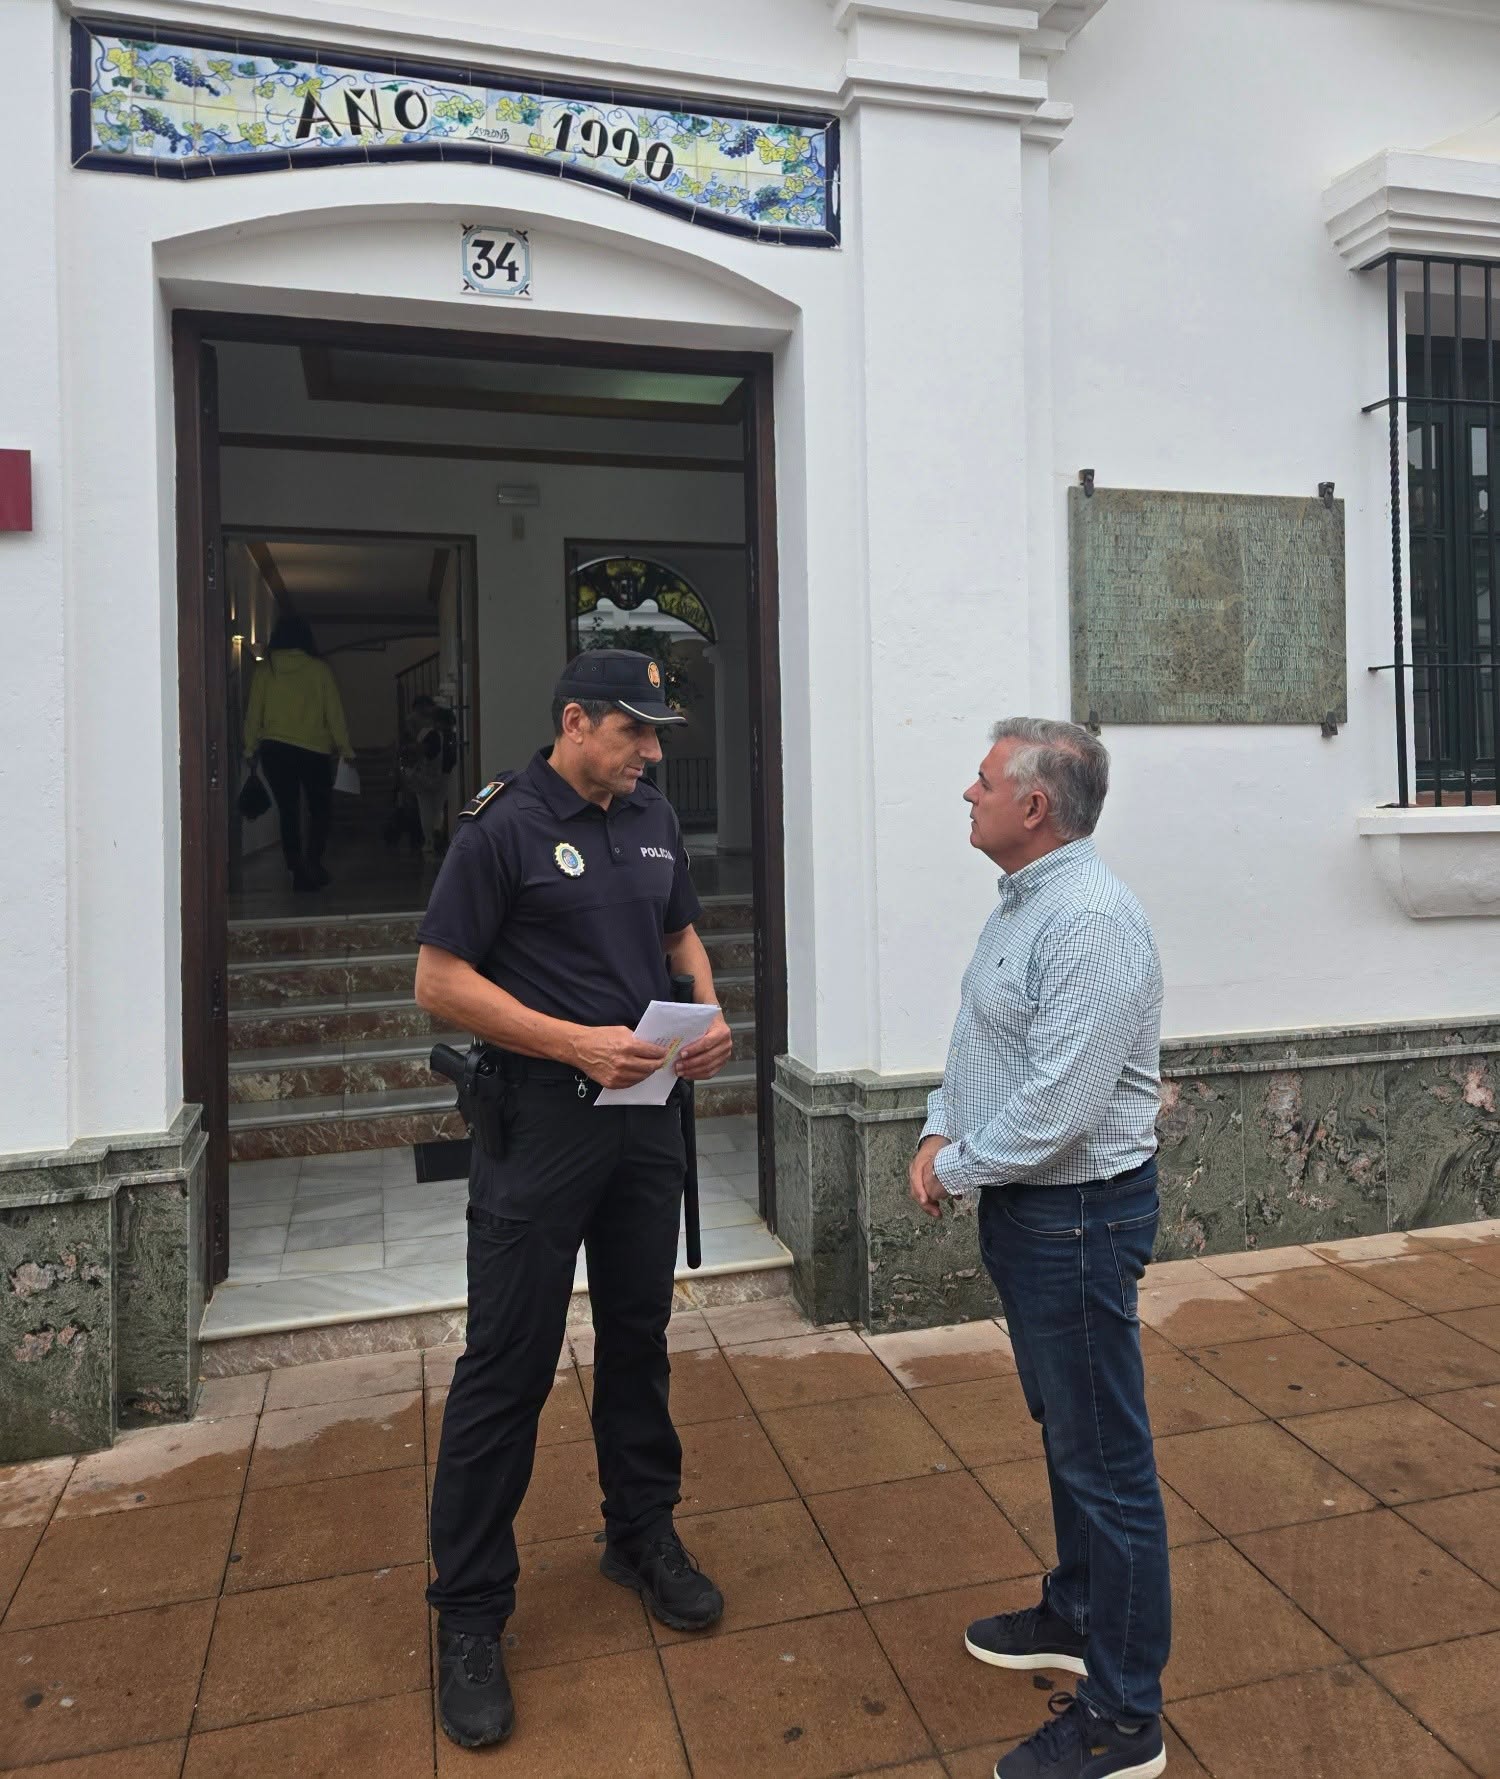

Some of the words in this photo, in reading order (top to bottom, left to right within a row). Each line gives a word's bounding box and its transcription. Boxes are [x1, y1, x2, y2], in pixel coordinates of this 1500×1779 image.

[296, 87, 428, 139] AÑO
[553, 113, 674, 182] 1990
[471, 239, 519, 283] 34
